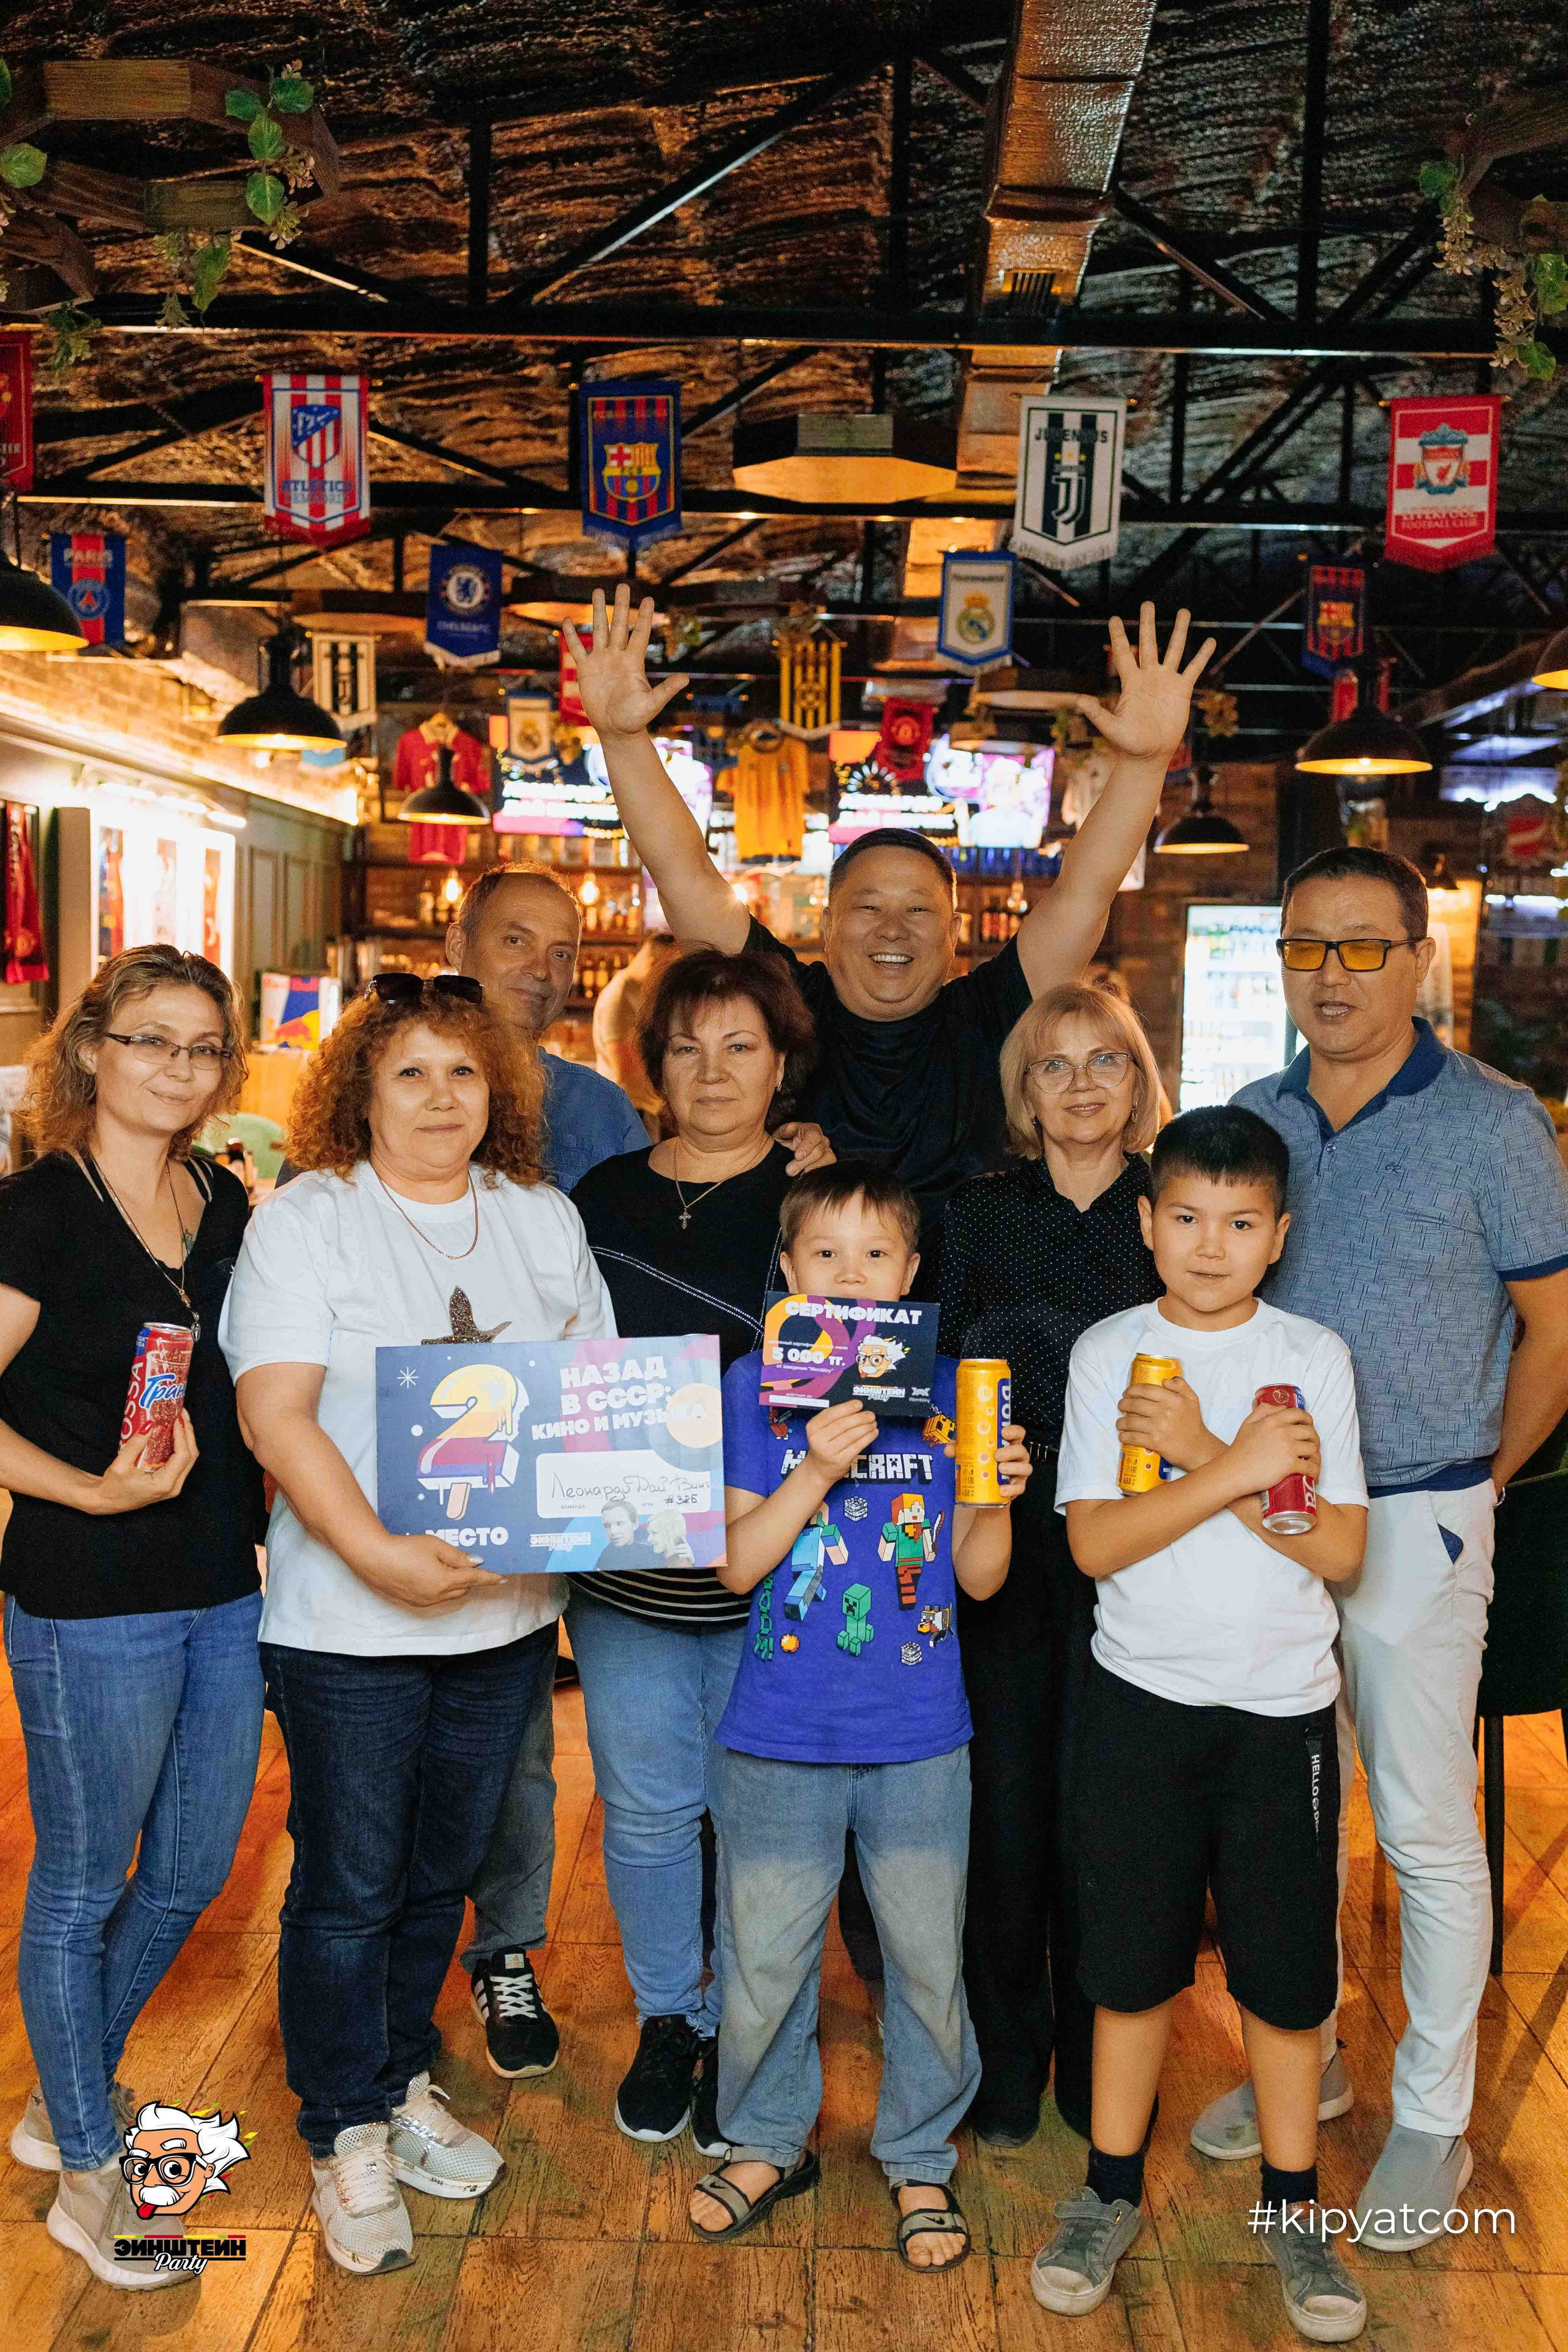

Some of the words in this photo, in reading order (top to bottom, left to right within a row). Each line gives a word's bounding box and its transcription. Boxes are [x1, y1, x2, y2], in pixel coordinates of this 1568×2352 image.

[785, 1301, 922, 1325] СЕРТИФИКАТ
[772, 1347, 784, 1360] 5
[787, 1348, 825, 1364] 000
[560, 1355, 667, 1389] НАЗАД
[560, 1393, 581, 1416] В
[587, 1382, 672, 1412] СССР:
[532, 1418, 590, 1441] КИНО
[593, 1415, 609, 1432] И
[780, 1449, 933, 1480] MCRAFT
[1311, 1754, 1321, 1796] HELLO
